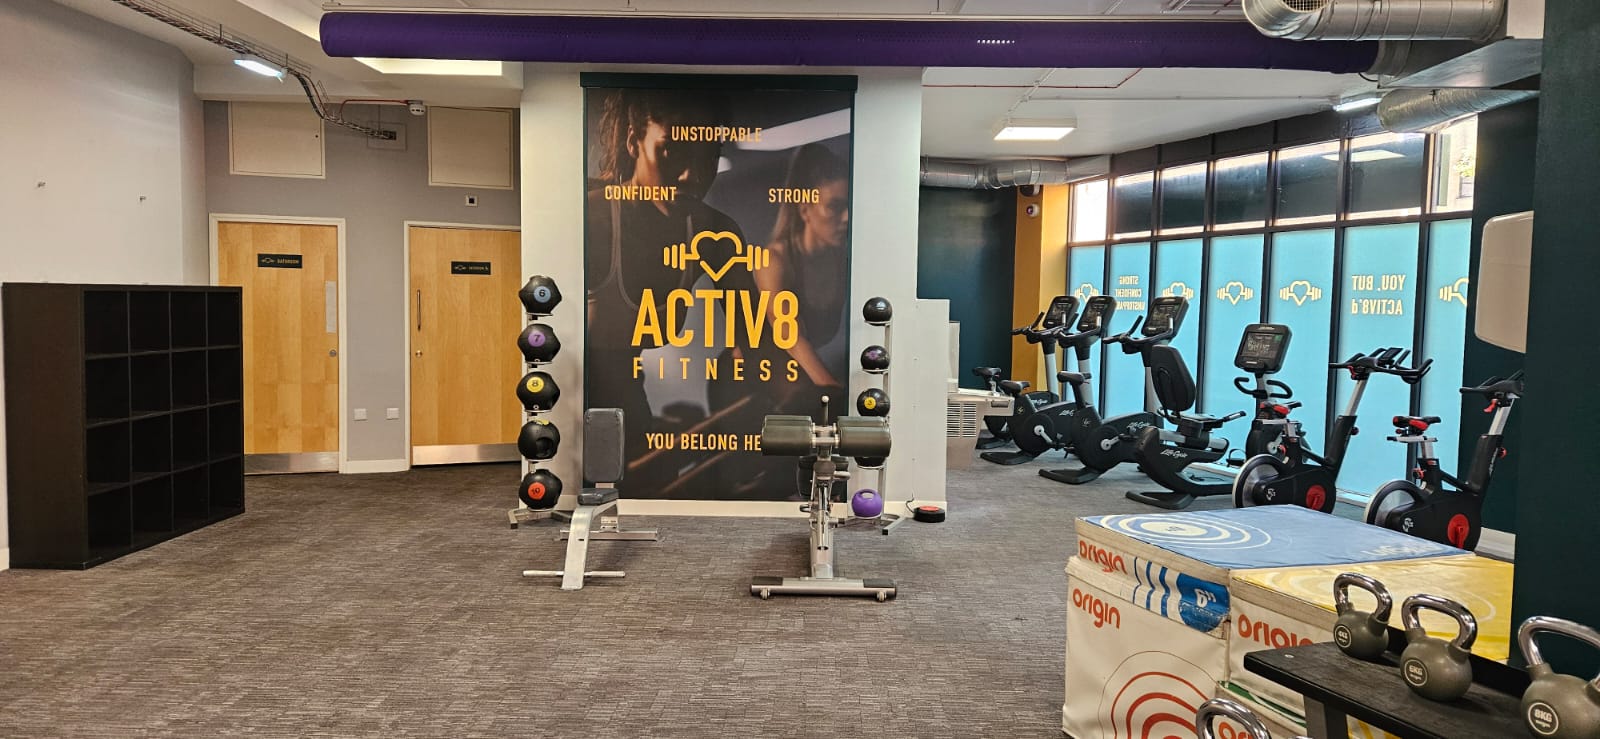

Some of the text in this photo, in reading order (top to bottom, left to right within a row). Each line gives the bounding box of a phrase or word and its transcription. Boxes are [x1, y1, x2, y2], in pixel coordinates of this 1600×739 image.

[671, 125, 763, 143] UNSTOPPABLE
[604, 185, 677, 202] CONFIDENT
[768, 188, 820, 204] STRONG
[538, 289, 546, 297] 6
[631, 288, 799, 350] ACTIV8
[534, 334, 541, 342] 7
[632, 356, 799, 382] FITNESS
[645, 432, 762, 451] YOU BELONG HE
[1079, 540, 1128, 575] origin
[1072, 588, 1121, 630] origin
[1534, 708, 1553, 723] 8KG
